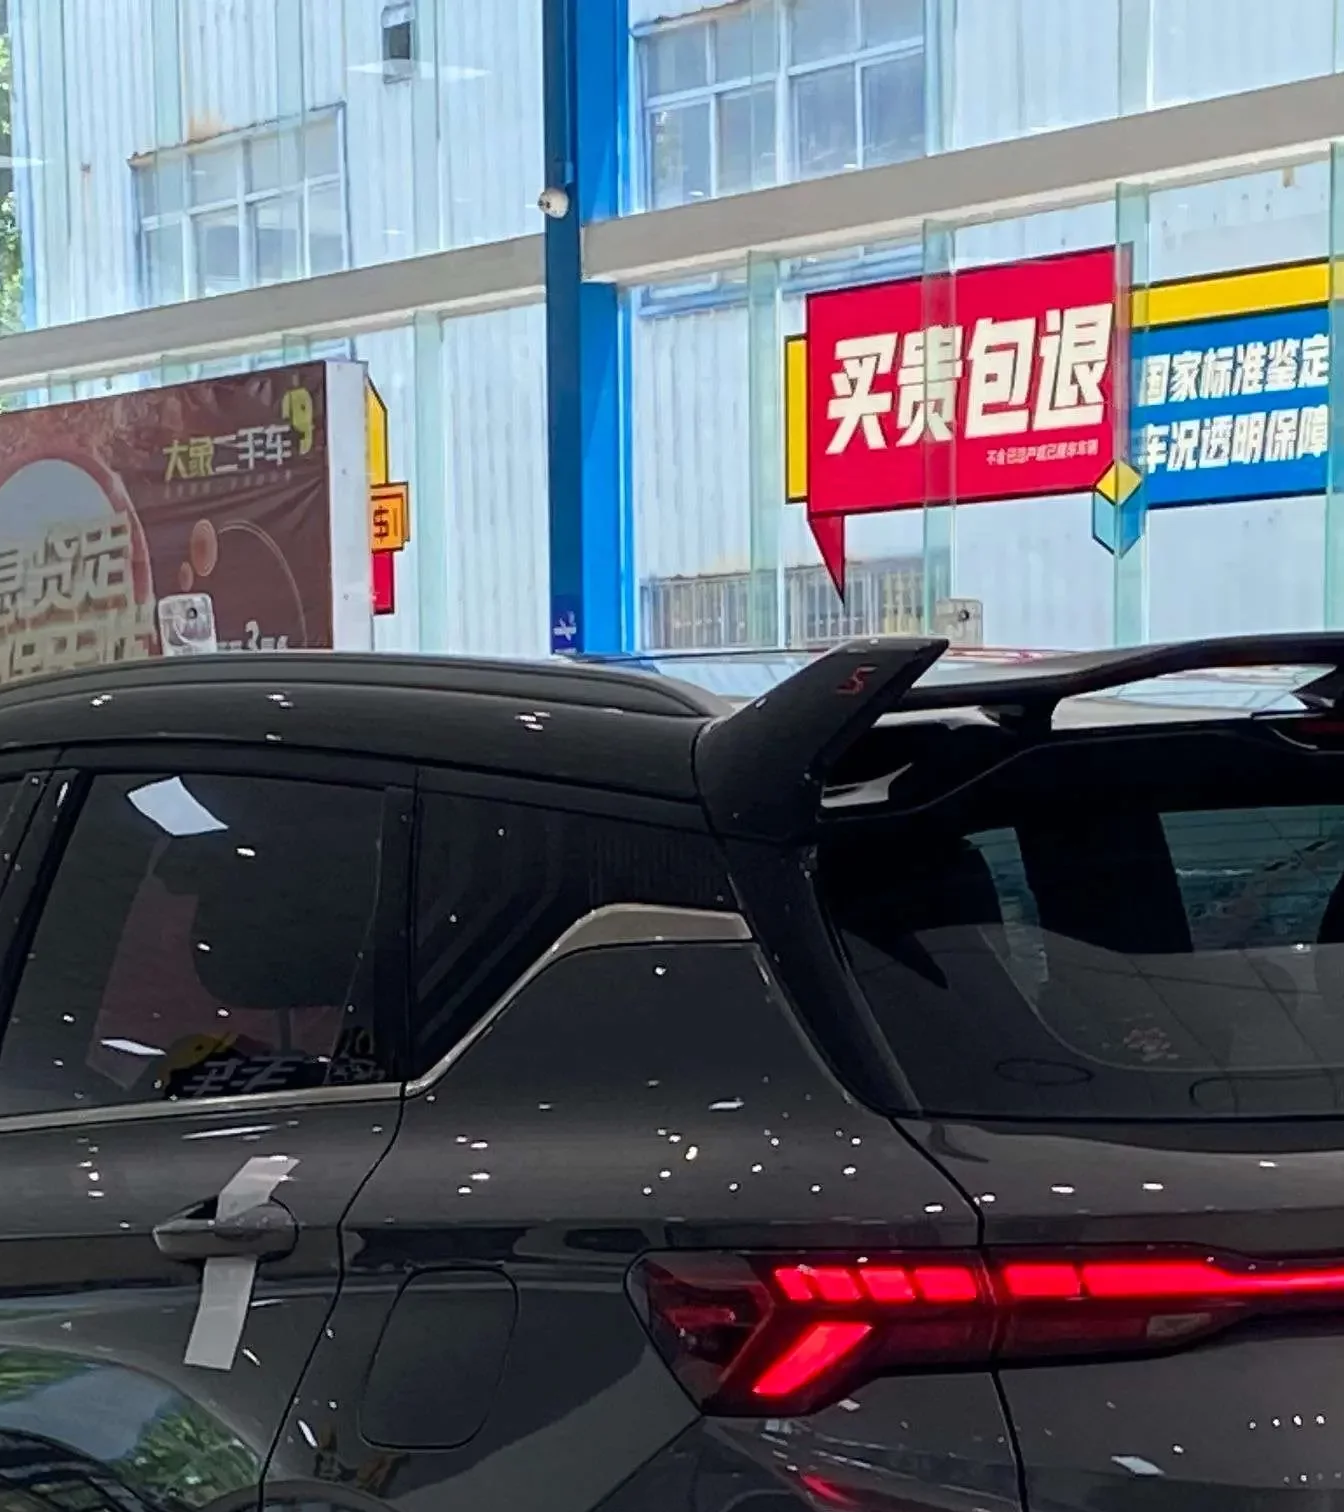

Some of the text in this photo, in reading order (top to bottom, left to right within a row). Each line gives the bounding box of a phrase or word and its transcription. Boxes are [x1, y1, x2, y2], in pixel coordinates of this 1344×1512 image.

[825, 302, 1115, 455] 买贵包退
[1139, 333, 1330, 407] 国家标准鉴定
[163, 423, 292, 481] 大象二手车
[1139, 403, 1330, 475] 车况透明保障
